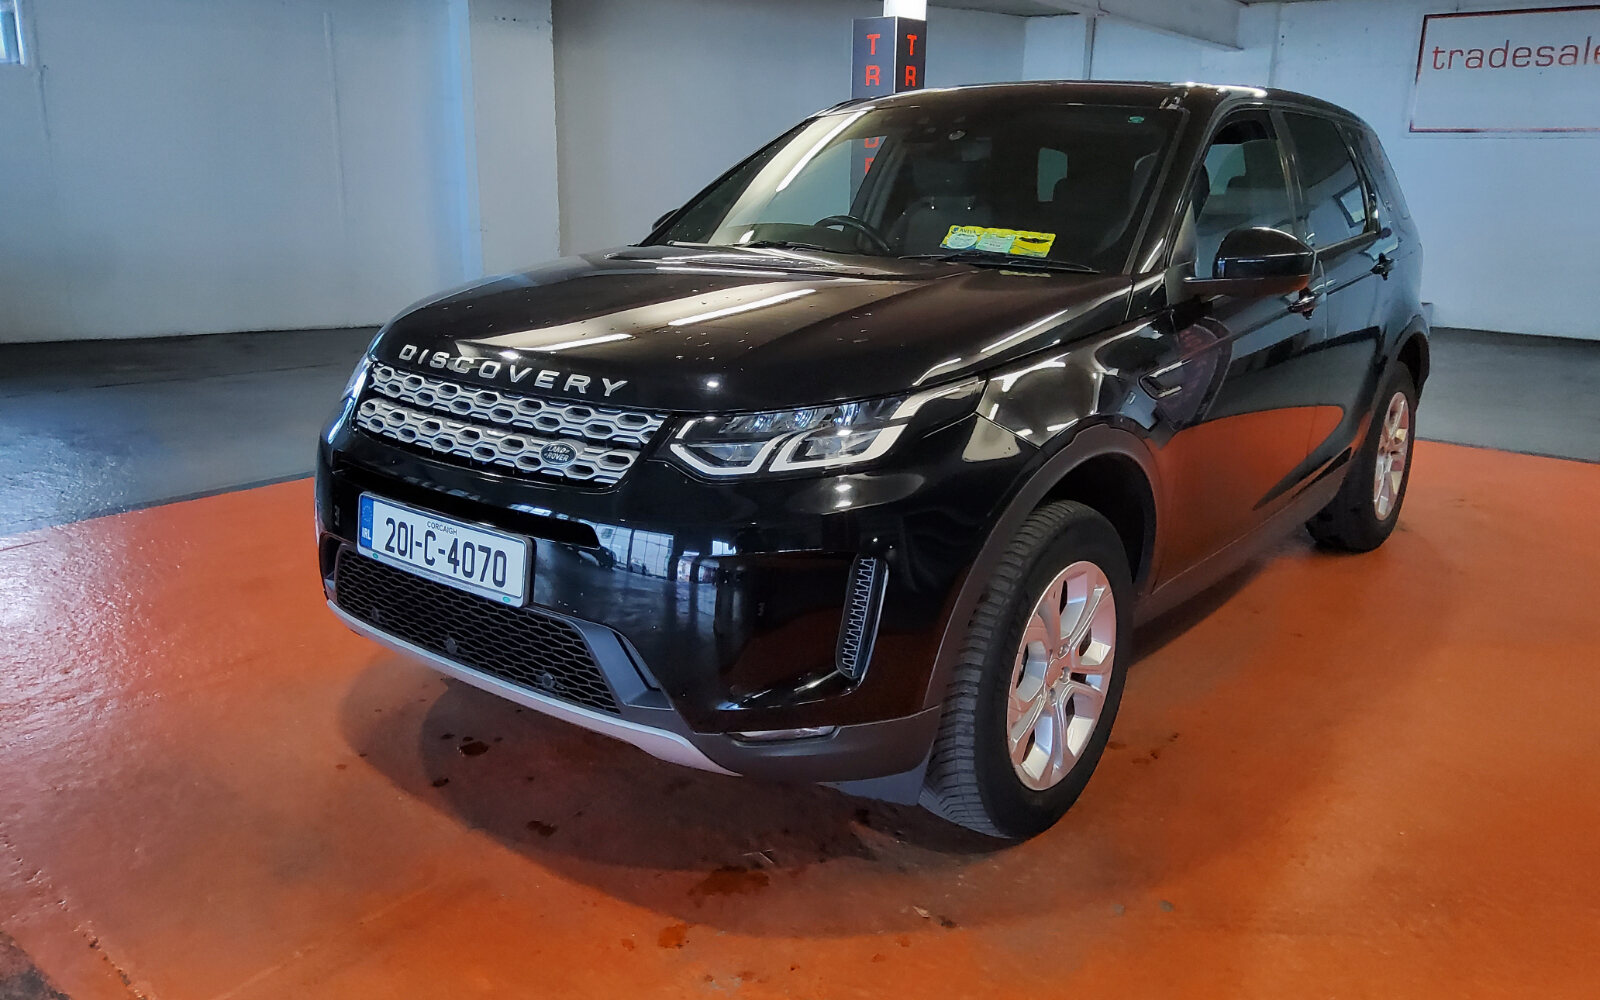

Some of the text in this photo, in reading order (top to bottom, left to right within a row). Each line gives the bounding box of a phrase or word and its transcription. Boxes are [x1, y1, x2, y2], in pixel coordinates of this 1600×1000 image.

[398, 344, 628, 397] DISCOVERY
[545, 452, 570, 462] ROVER
[547, 445, 568, 454] LAND
[426, 520, 458, 536] CORCAIGH
[384, 517, 508, 588] 201-C-4070
